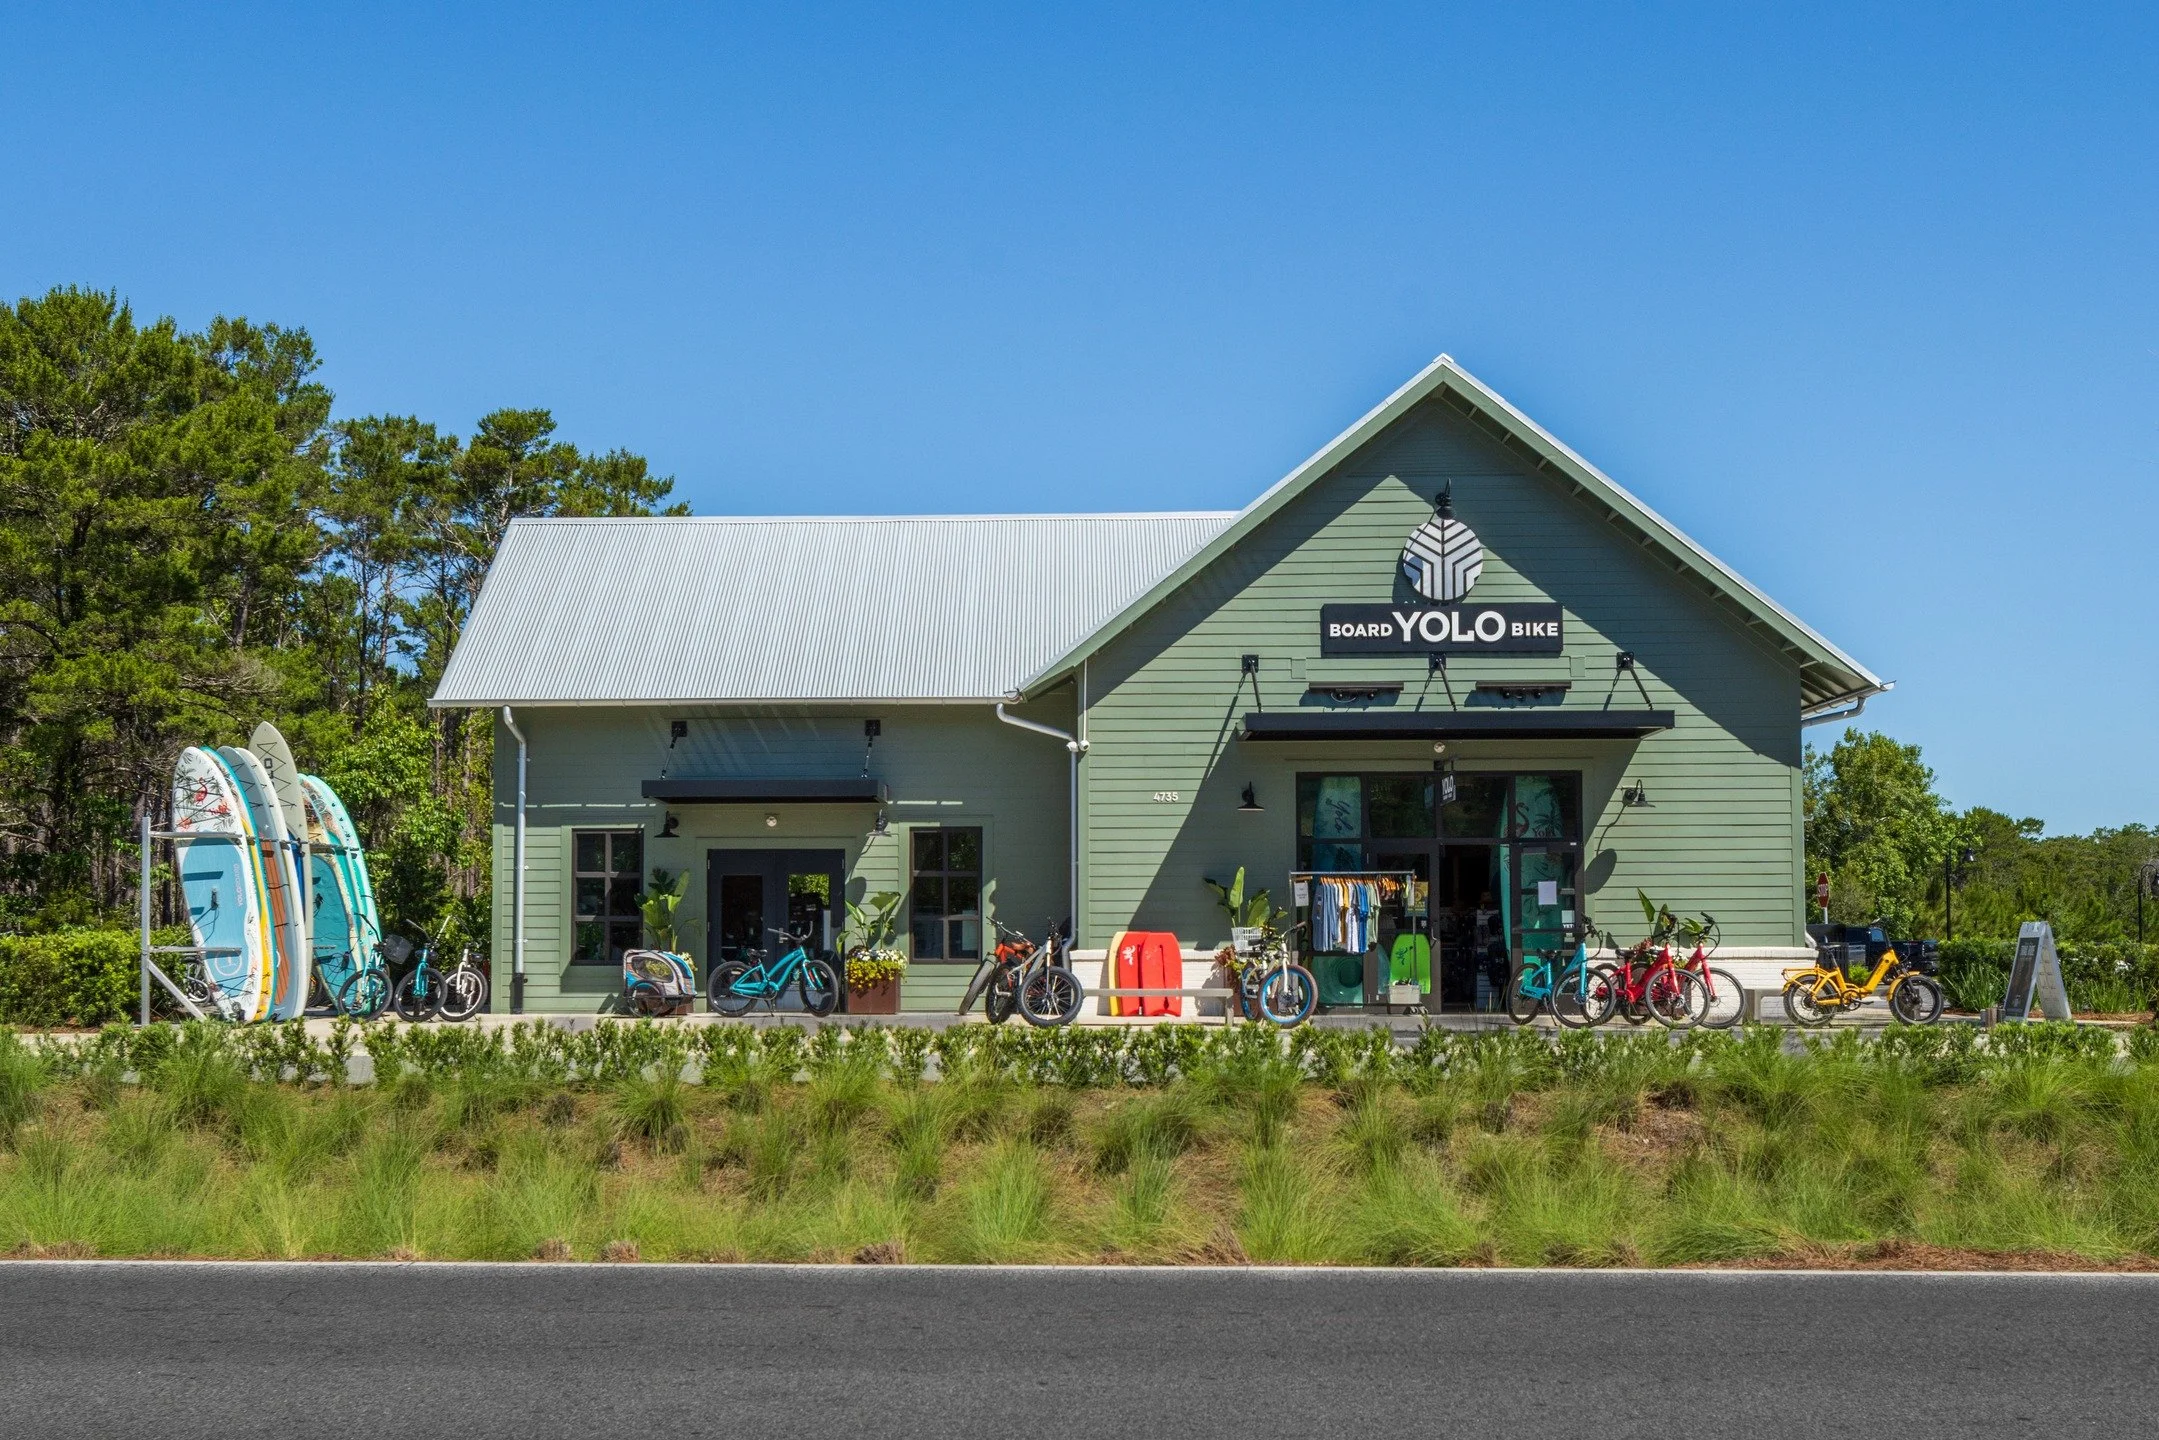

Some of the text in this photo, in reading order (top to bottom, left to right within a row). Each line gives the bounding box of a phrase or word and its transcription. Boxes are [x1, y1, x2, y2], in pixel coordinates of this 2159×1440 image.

[1329, 610, 1559, 643] BOARD YOLO BIKE
[1152, 791, 1179, 802] 4735
